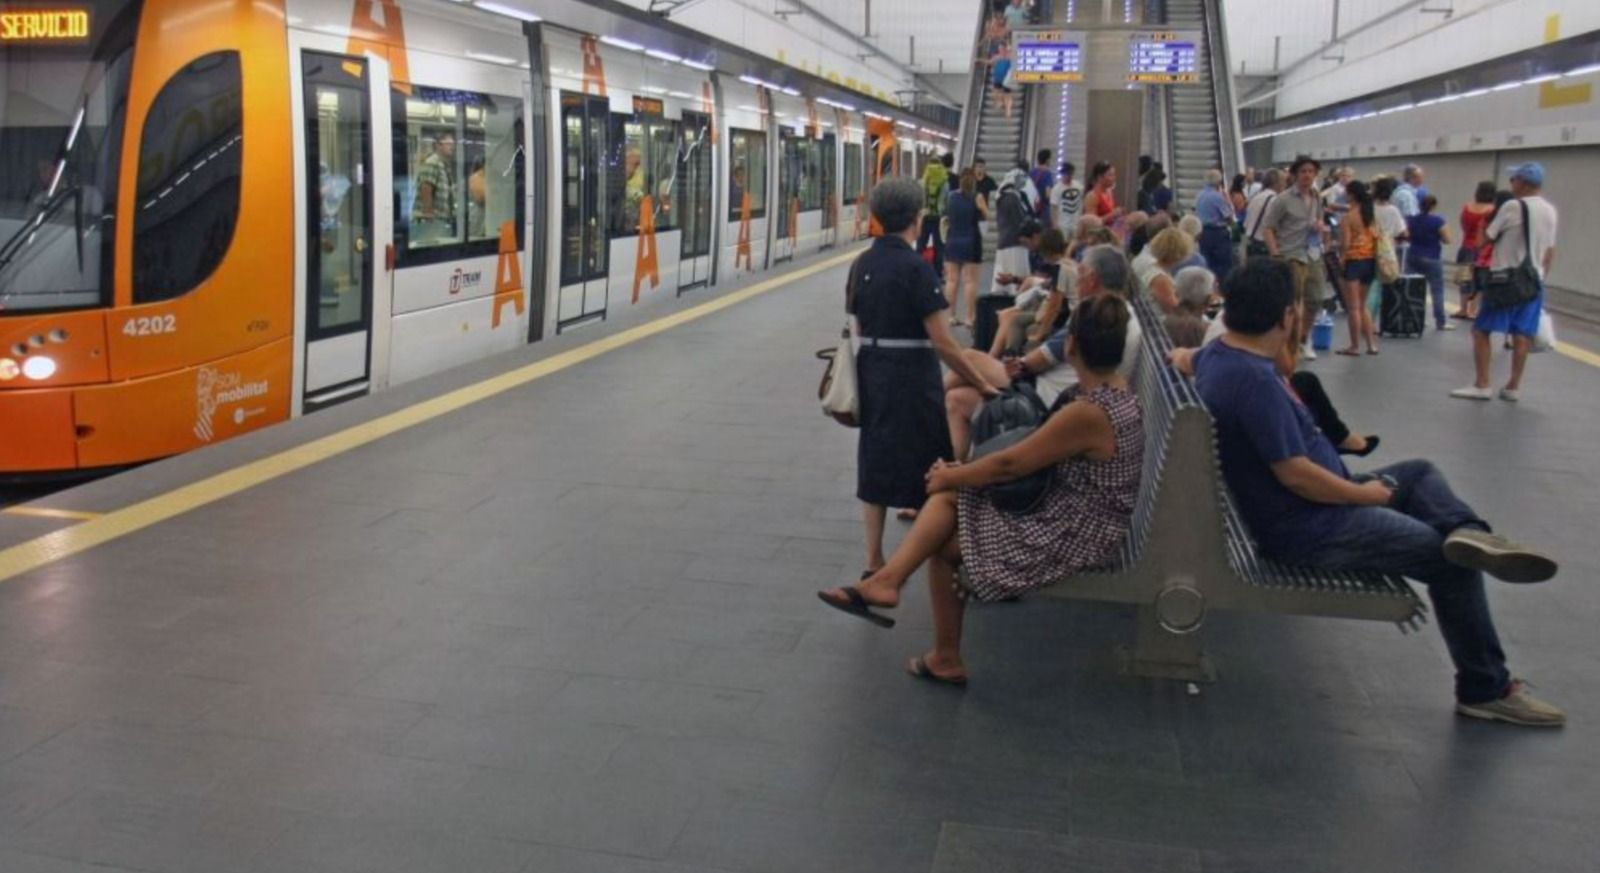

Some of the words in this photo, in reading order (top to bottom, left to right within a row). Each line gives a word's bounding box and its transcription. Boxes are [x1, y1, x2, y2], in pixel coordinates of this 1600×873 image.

[1, 11, 87, 39] SERVICIO
[492, 220, 525, 329] A
[122, 314, 177, 336] 4202
[217, 380, 268, 404] mobilitat
